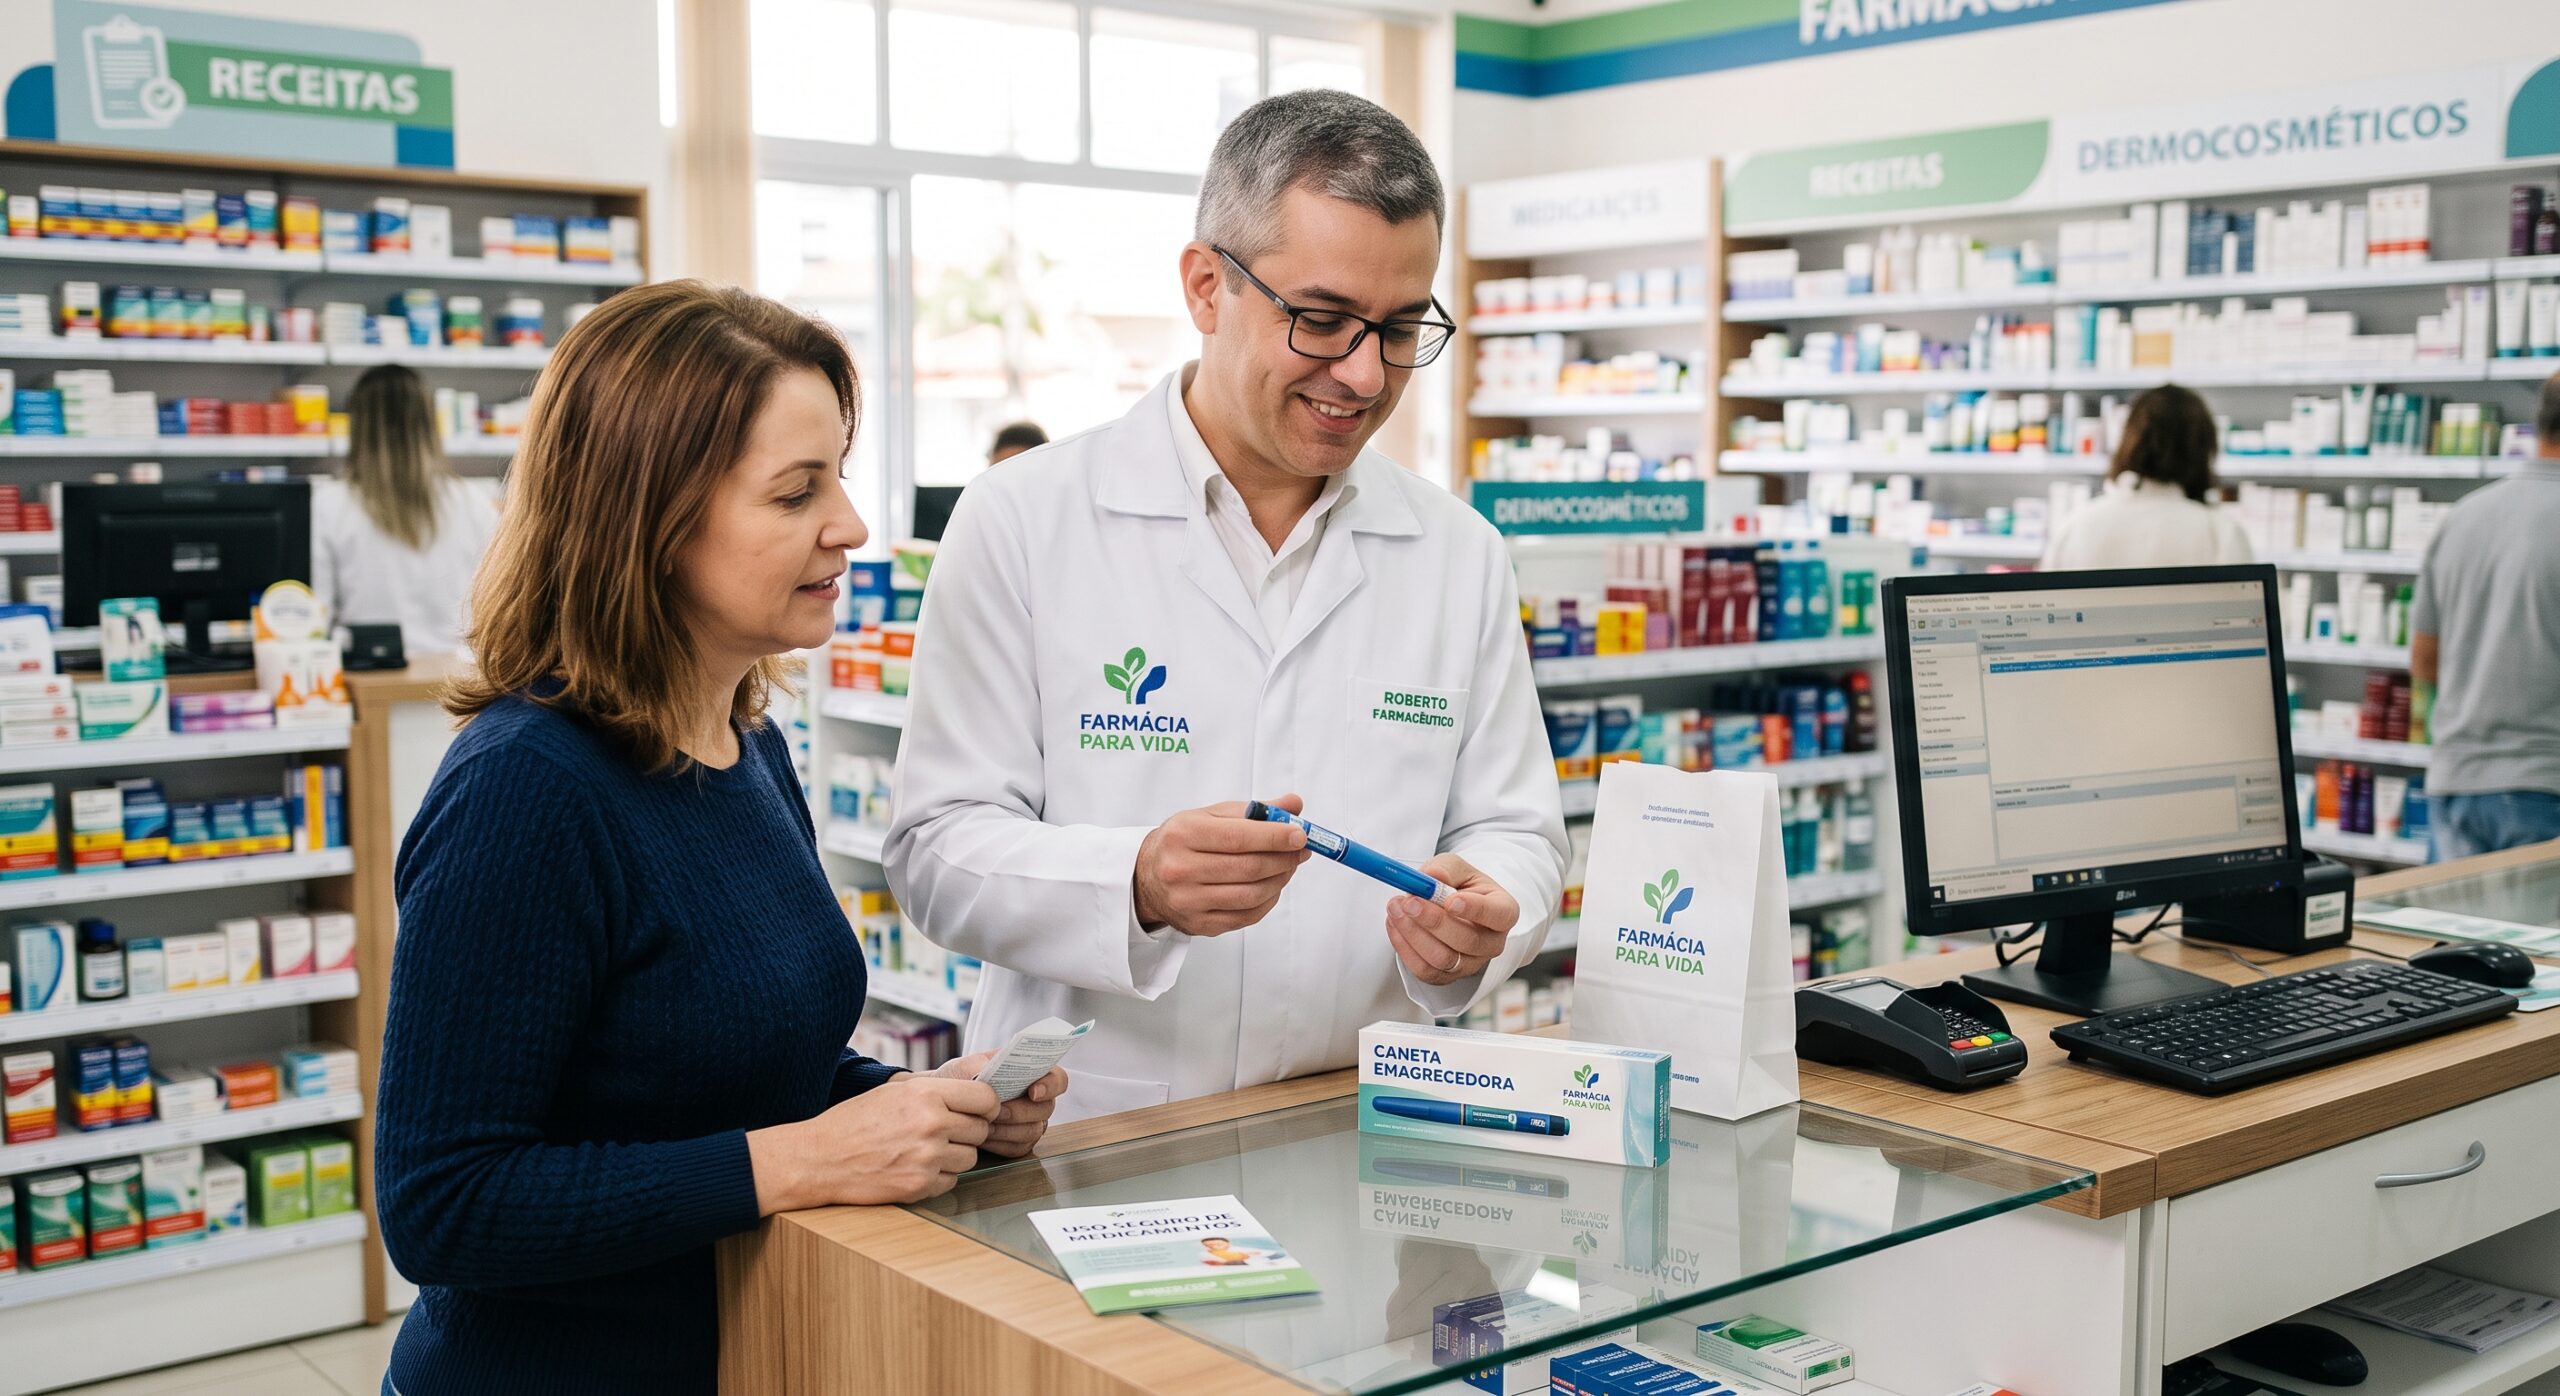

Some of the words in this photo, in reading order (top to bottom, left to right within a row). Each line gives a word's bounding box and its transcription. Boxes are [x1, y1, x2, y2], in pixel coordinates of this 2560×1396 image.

[210, 57, 420, 115] RECEITAS
[2078, 100, 2469, 173] DERMOCOSMÉTICOS
[1809, 153, 1944, 198] RECEITAS
[1494, 491, 1689, 523] DERMOCOSMÉTICOS
[1384, 691, 1448, 710] ROBERTO
[1080, 711, 1190, 734] FARMÁCIA
[1372, 708, 1454, 728] FARMACÊUTICO
[1080, 733, 1135, 751] PARA
[1141, 735, 1190, 754] VIDA
[1617, 927, 1706, 957] FARMÁCIA
[1616, 946, 1659, 968] PARA
[1664, 951, 1705, 975] VIDA
[1373, 1044, 1441, 1065] CANETA
[1373, 1062, 1515, 1091] EMAGRECEDORA
[1562, 1098, 1587, 1110] PARA
[1589, 1100, 1611, 1112] VIDA
[1062, 1224, 1108, 1234] USO
[1113, 1215, 1200, 1229] SEGURO
[1206, 1212, 1234, 1222] DE
[1068, 1221, 1242, 1242] MEDICAMENTOS
